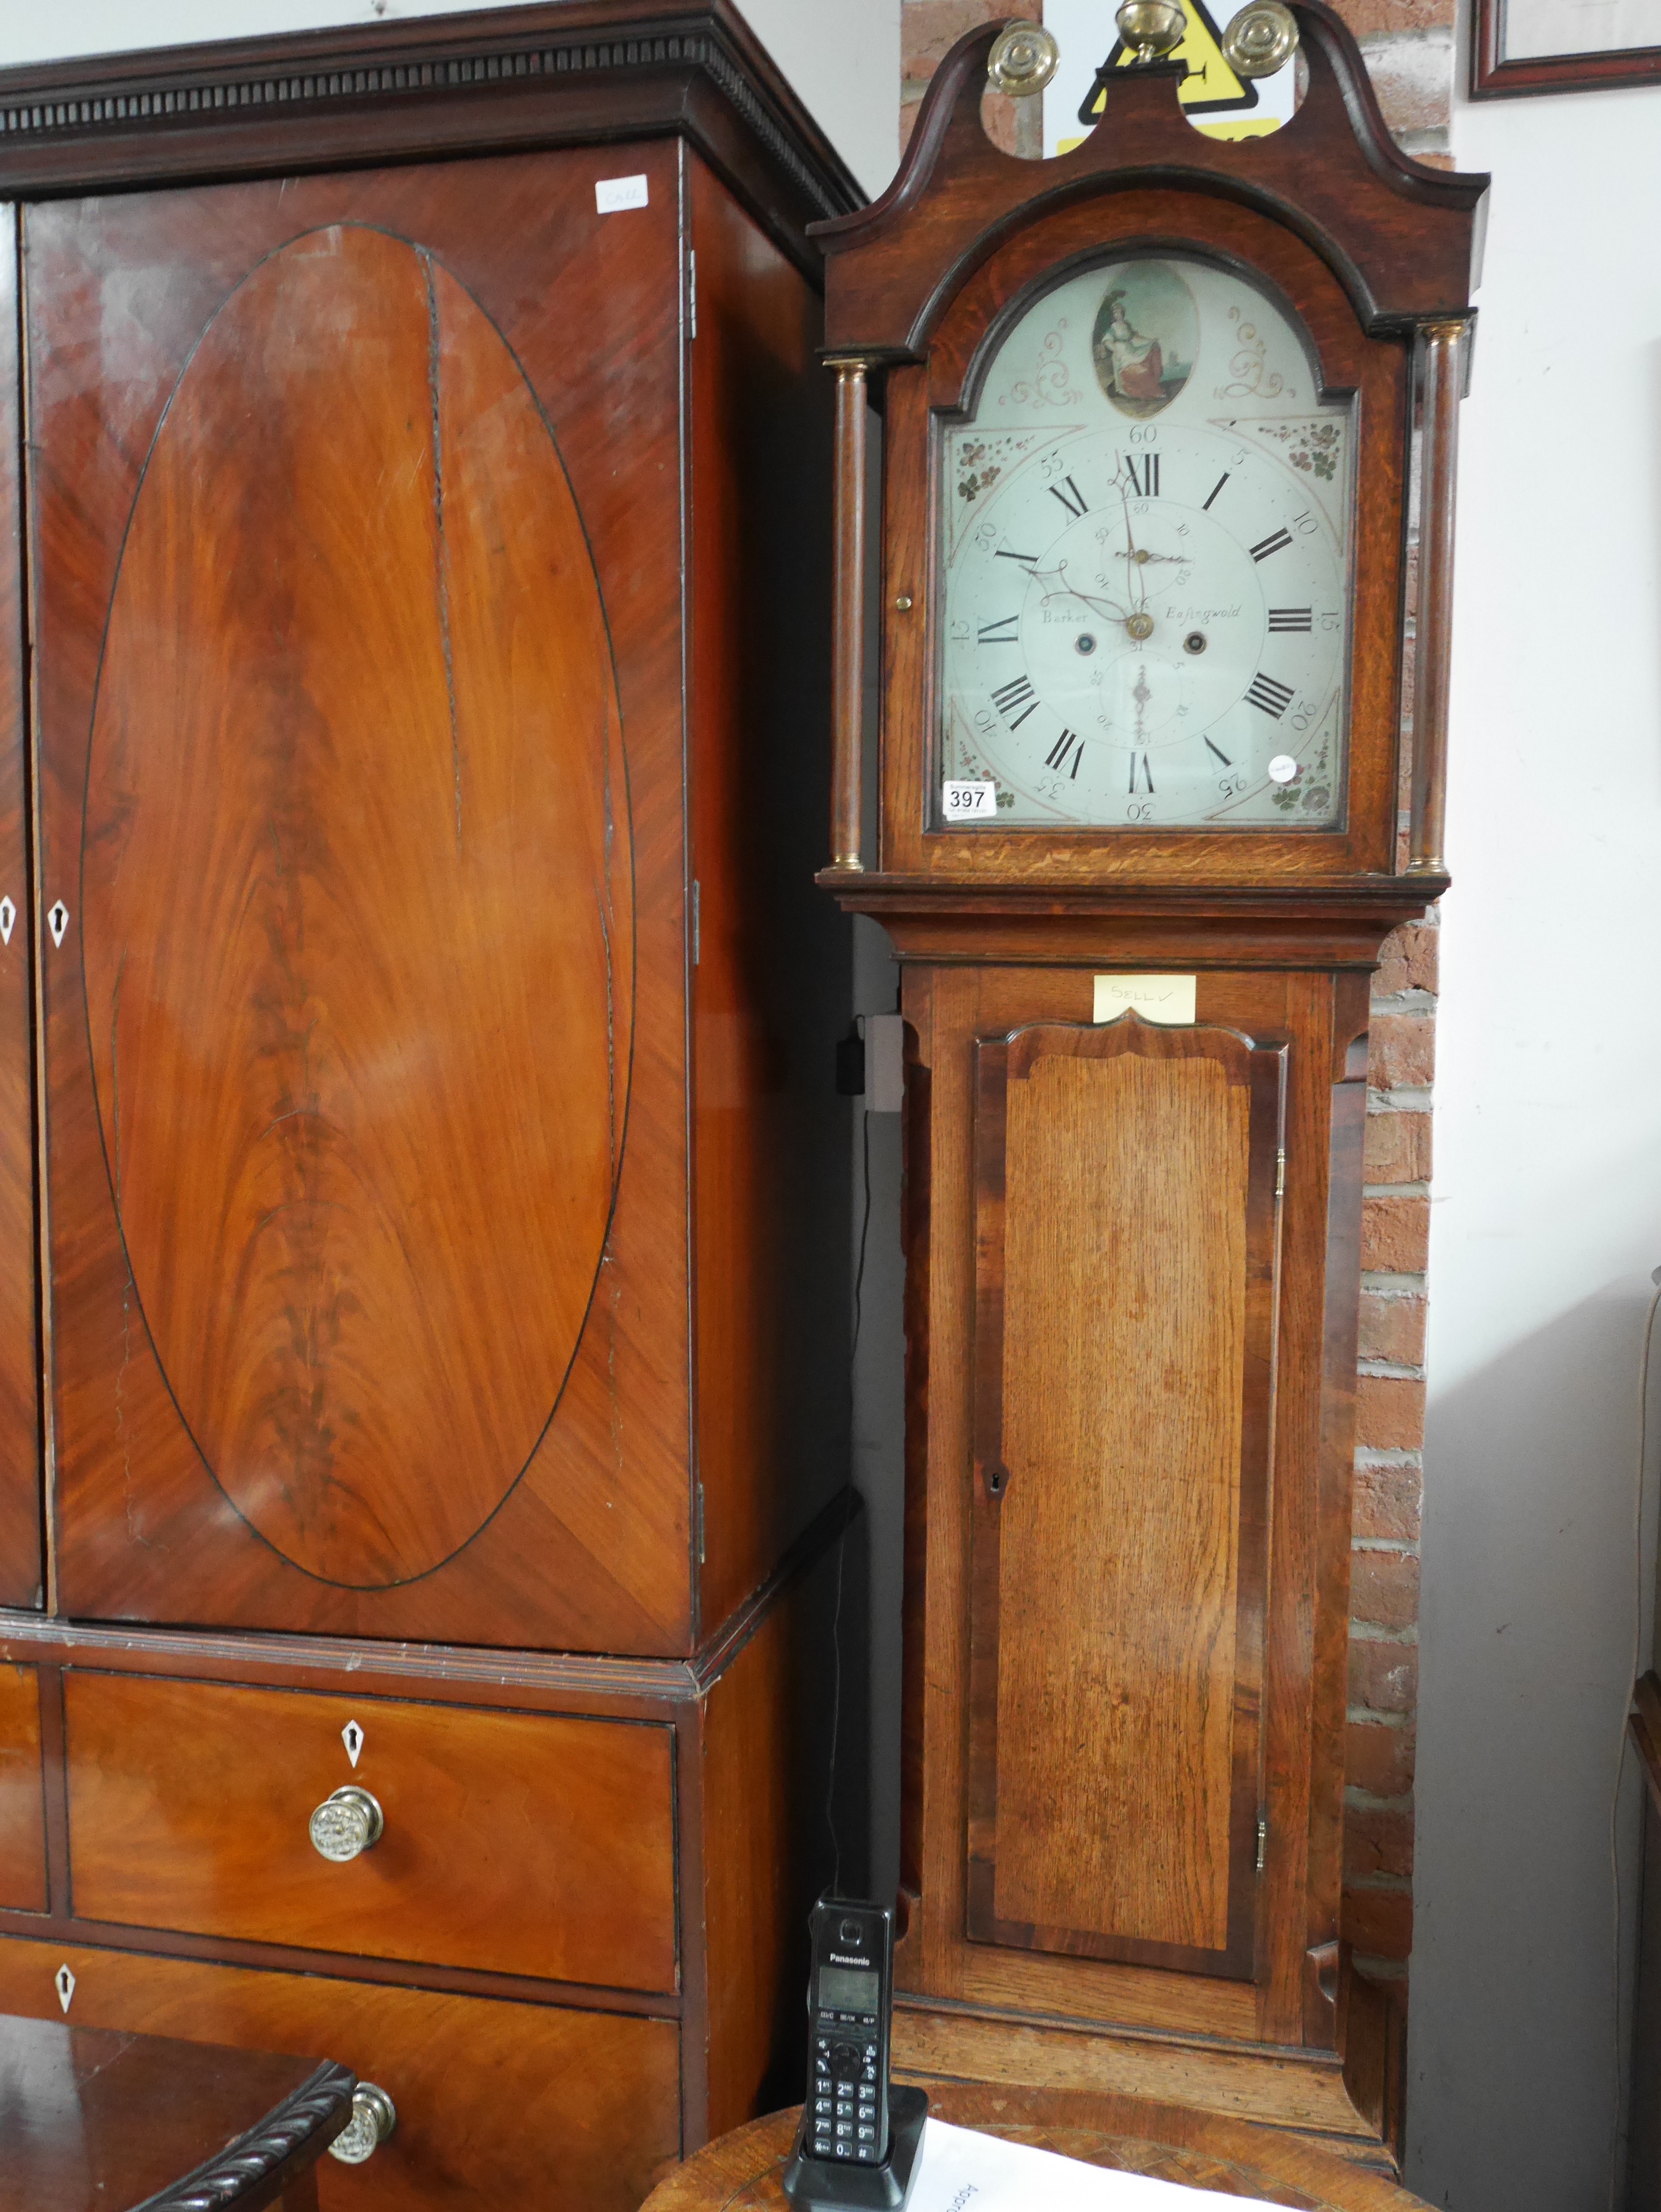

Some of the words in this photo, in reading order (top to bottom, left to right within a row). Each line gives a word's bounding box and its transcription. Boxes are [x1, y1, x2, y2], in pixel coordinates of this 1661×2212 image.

[1130, 424, 1157, 444] 60
[1041, 449, 1064, 478] 55
[1134, 503, 1149, 514] 60
[1293, 510, 1318, 535] 10
[975, 523, 997, 552] 50
[1043, 609, 1087, 624] Barker
[1291, 701, 1317, 731] 20
[1218, 772, 1247, 800] 25
[950, 791, 985, 807] 397
[1127, 803, 1155, 820] 30
[830, 1953, 870, 1966] Panasonic
[817, 2081, 822, 2092] 1
[838, 2084, 844, 2095] 2
[859, 2086, 866, 2098] 3
[816, 2101, 823, 2112] 4
[837, 2104, 843, 2115] 5
[859, 2107, 866, 2119] 6
[816, 2120, 822, 2132] 7
[837, 2124, 844, 2135] 8
[859, 2127, 865, 2138] 9
[837, 2144, 844, 2156] 0
